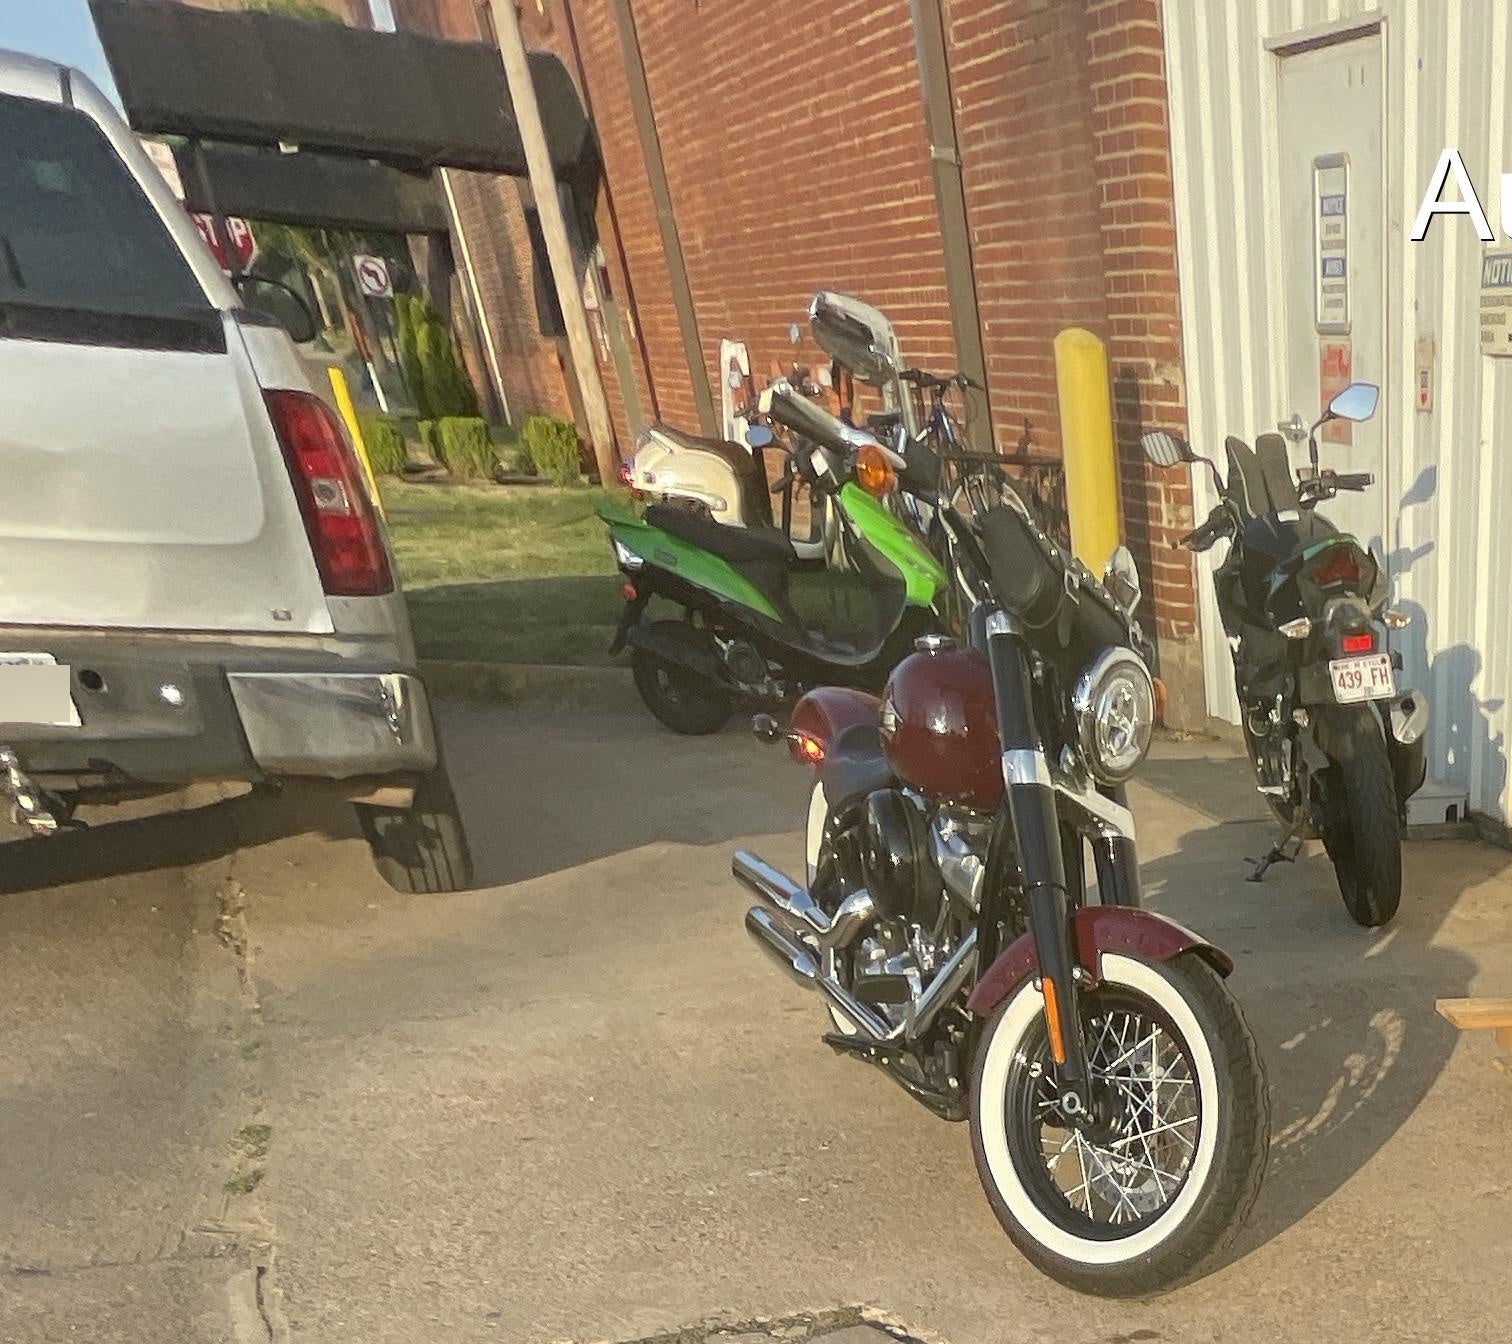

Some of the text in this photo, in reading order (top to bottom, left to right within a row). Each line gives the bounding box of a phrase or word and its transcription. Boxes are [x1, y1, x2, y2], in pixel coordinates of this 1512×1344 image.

[192, 212, 247, 248] STP
[1338, 666, 1390, 690] 439 FH
